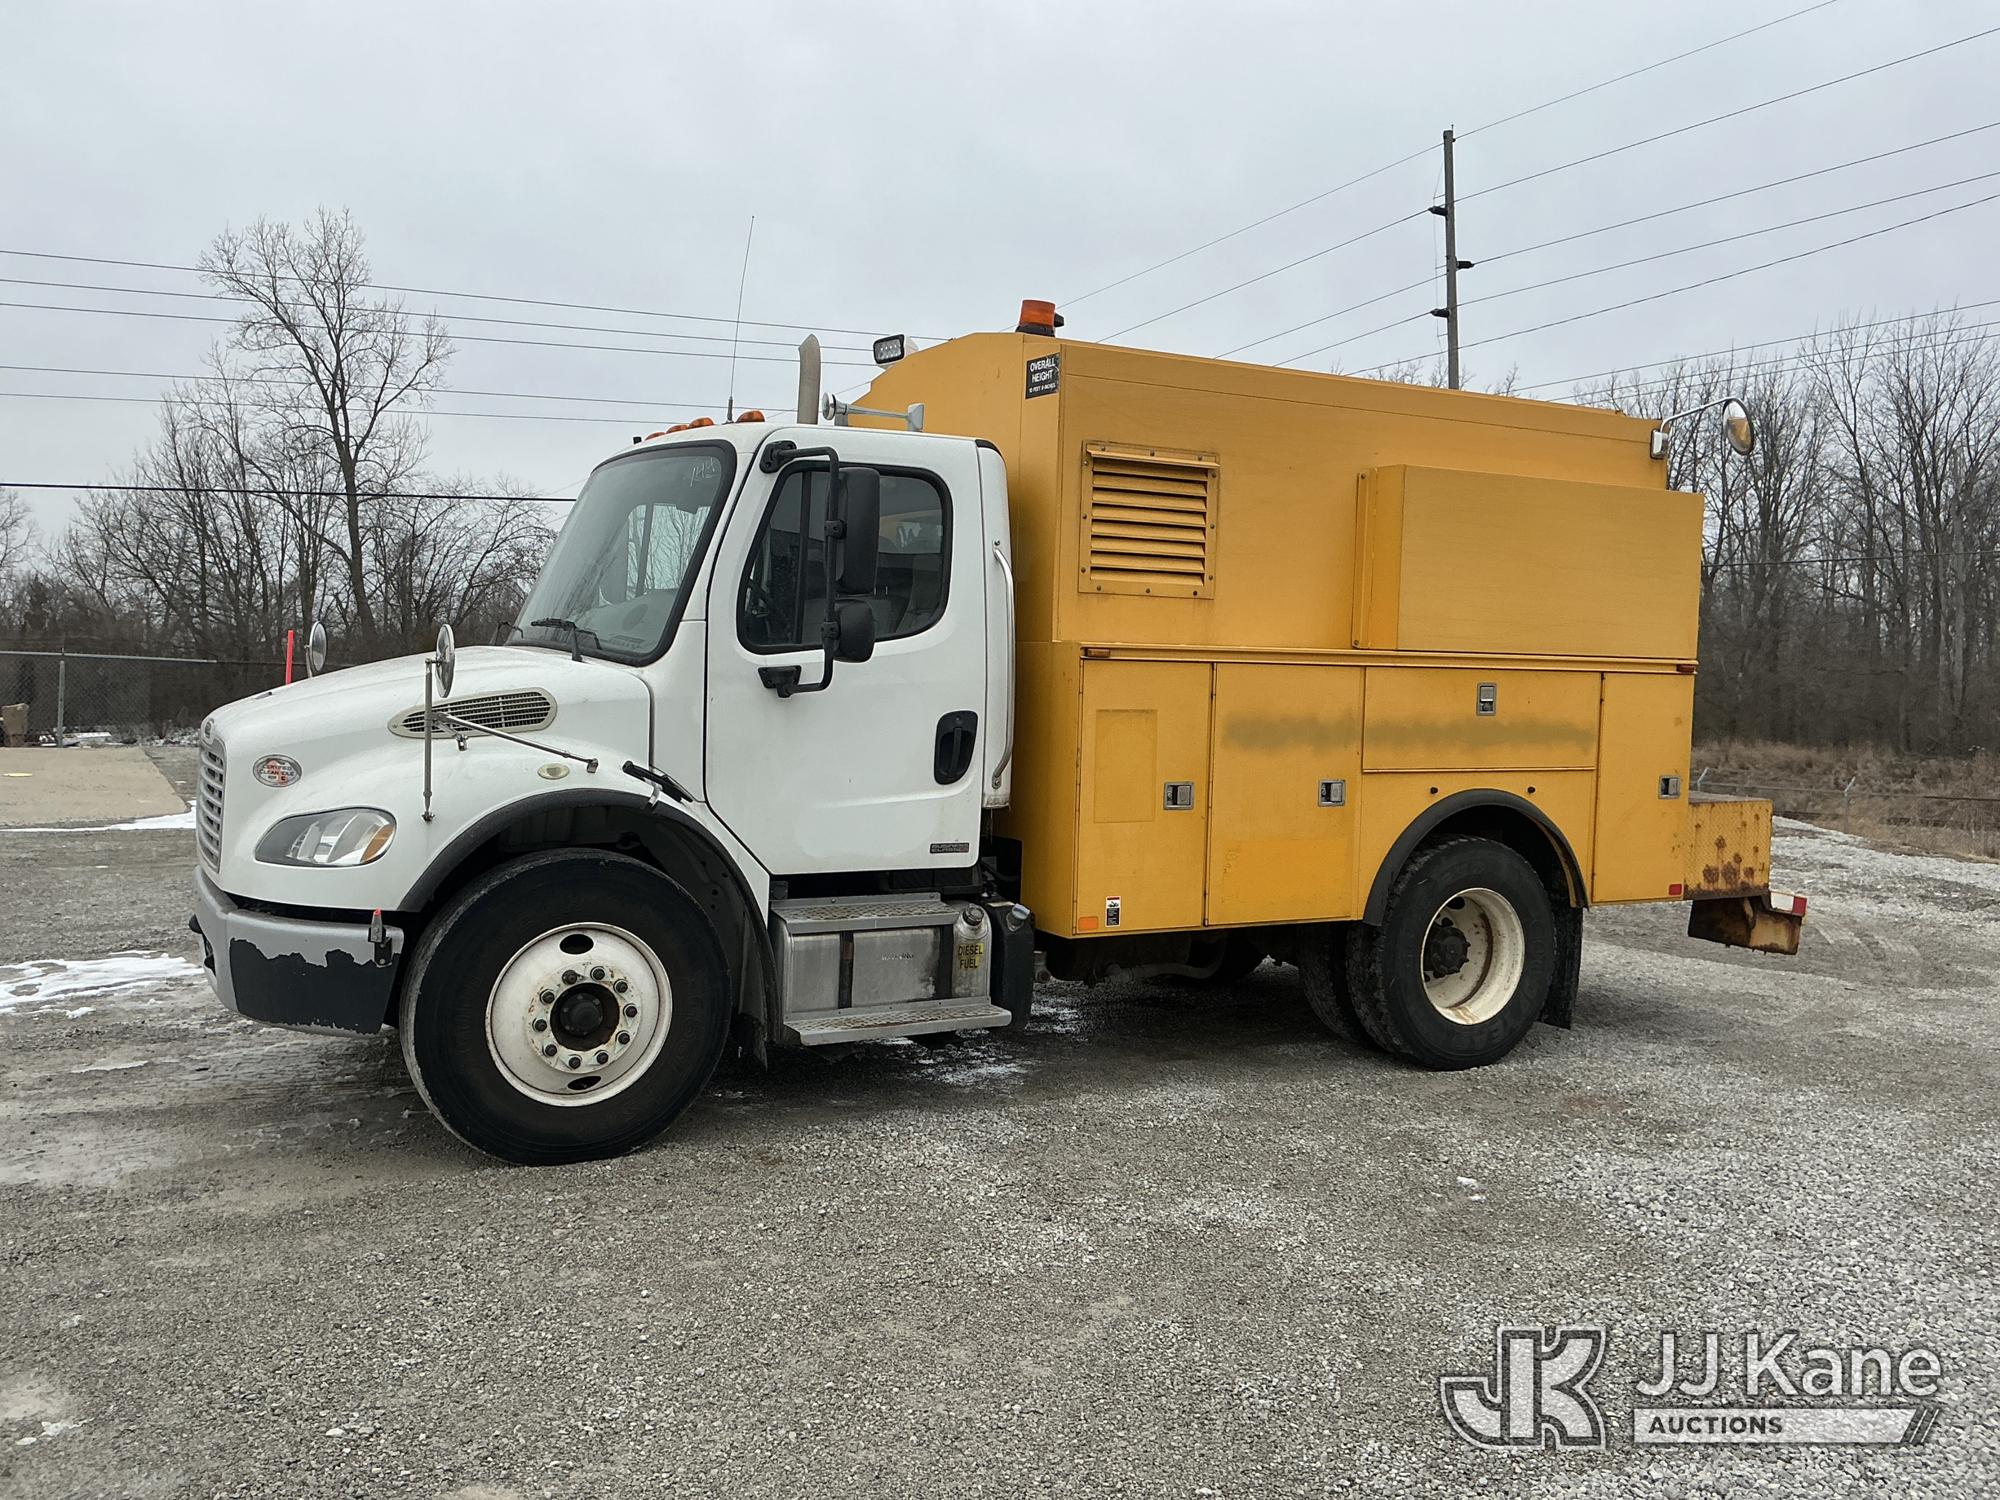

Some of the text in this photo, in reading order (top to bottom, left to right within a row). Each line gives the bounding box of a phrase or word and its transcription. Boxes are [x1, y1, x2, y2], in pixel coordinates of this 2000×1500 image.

[1030, 357, 1056, 372] OVERALL
[1031, 369, 1054, 383] HEIGHT
[958, 944, 983, 956] DIESEL
[960, 958, 978, 969] FUEL
